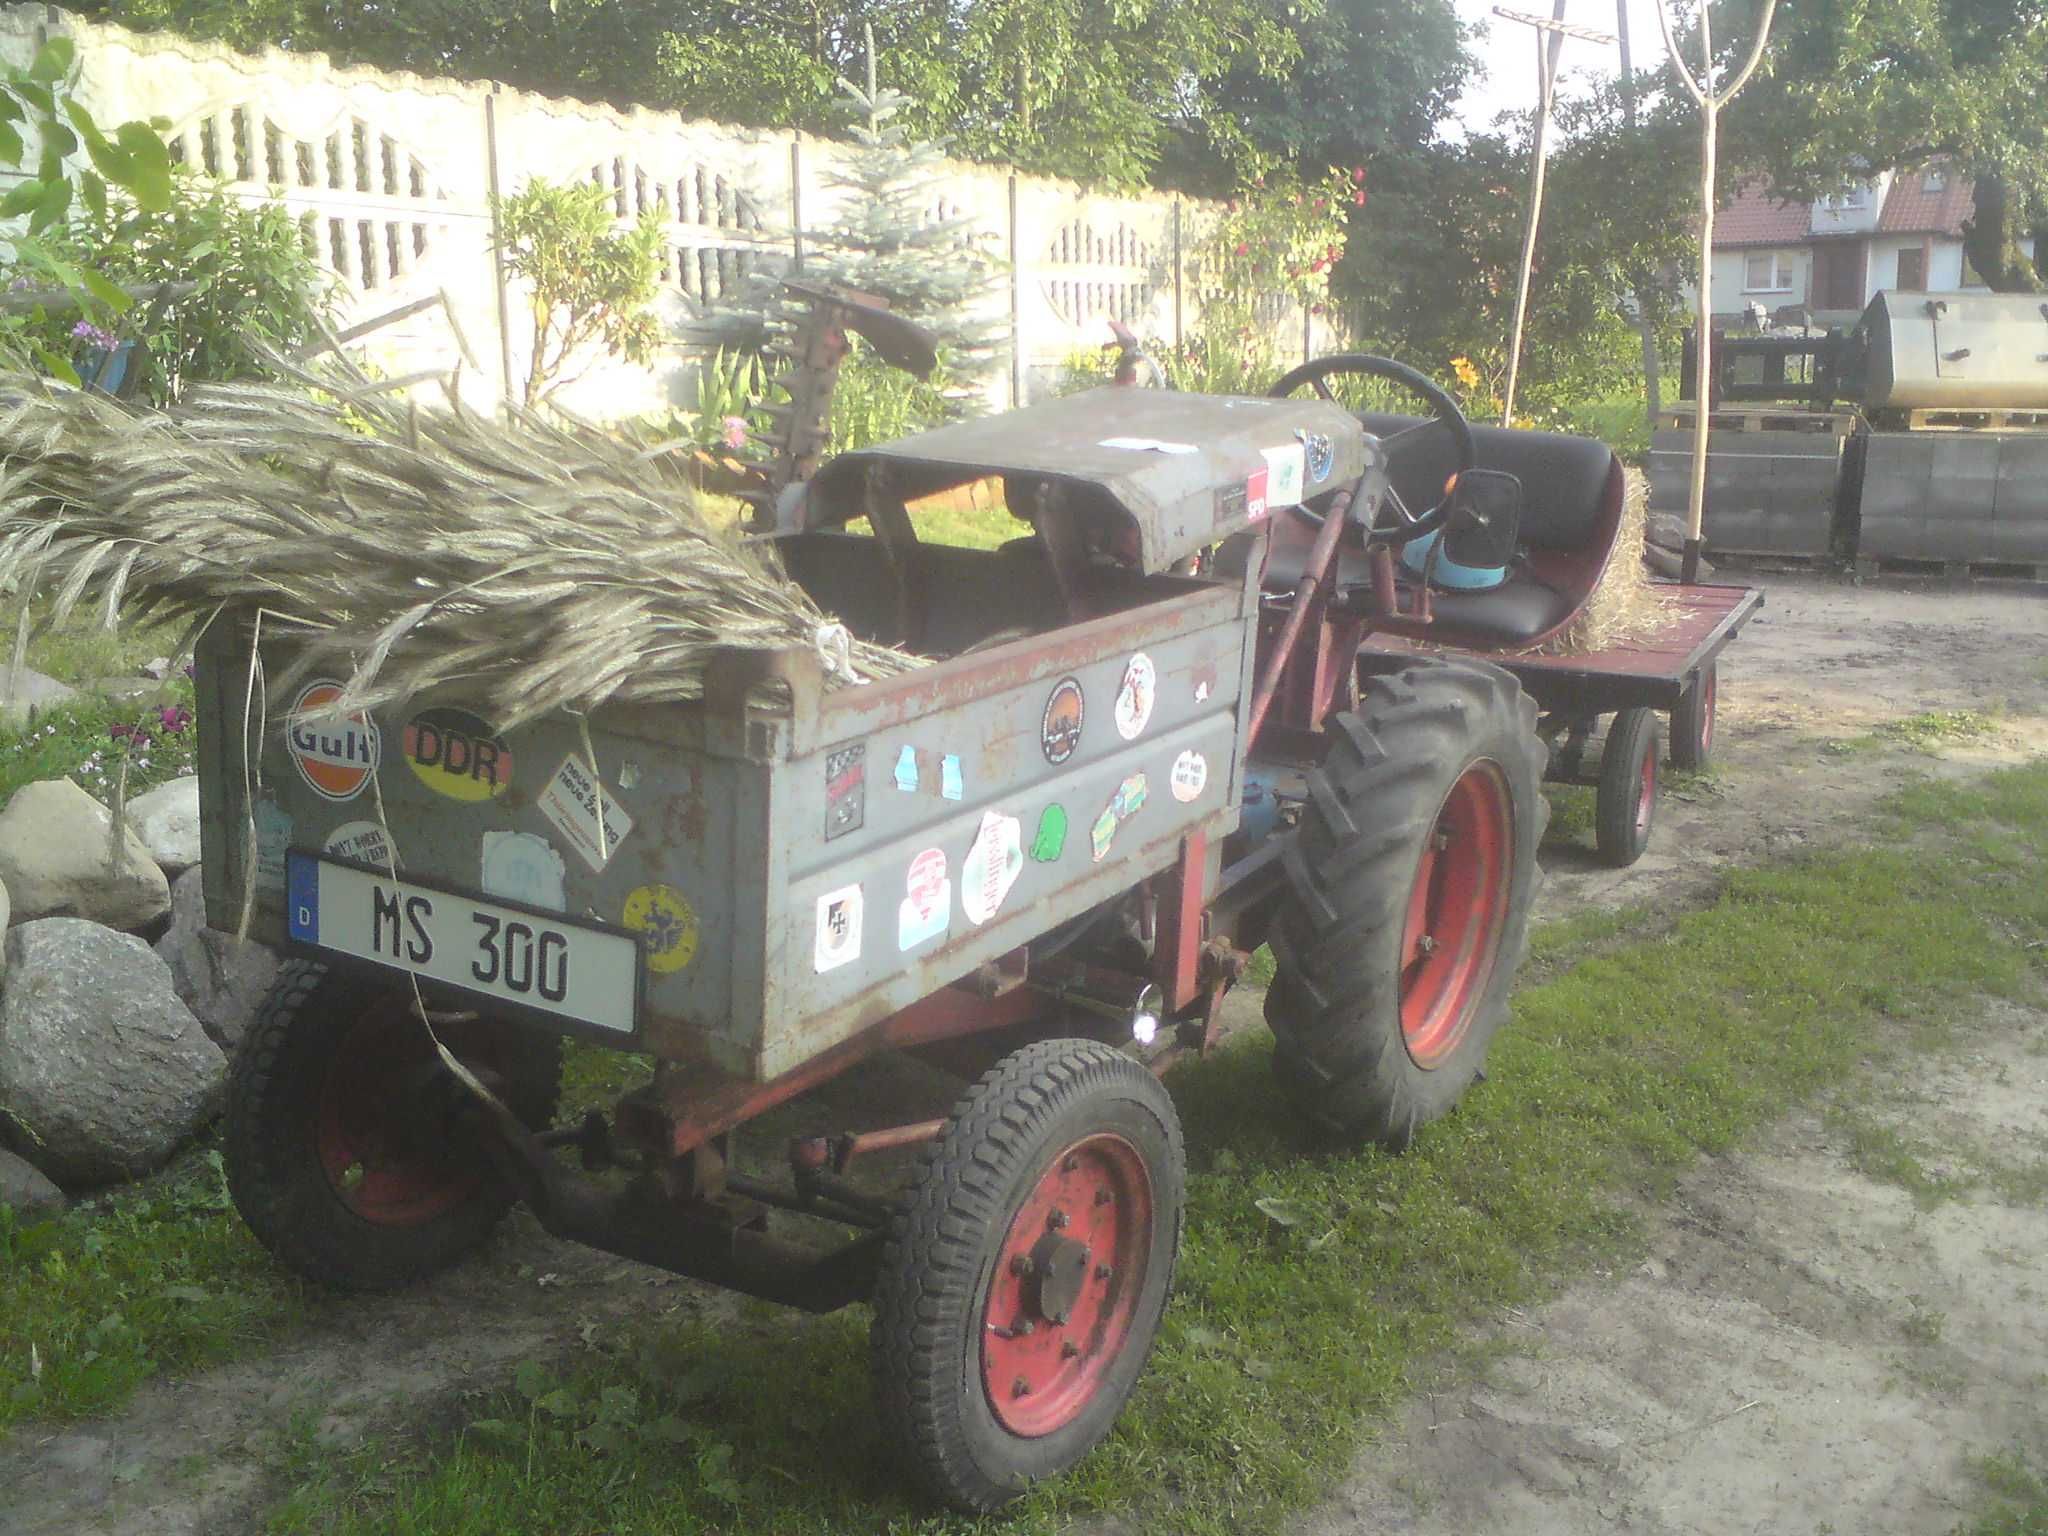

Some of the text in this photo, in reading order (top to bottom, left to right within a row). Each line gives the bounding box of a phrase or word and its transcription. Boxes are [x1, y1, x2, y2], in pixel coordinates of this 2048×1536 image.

[291, 726, 374, 763] Gulf
[416, 719, 497, 785] DDR
[559, 772, 584, 801] neue
[373, 885, 569, 1002] MS 300
